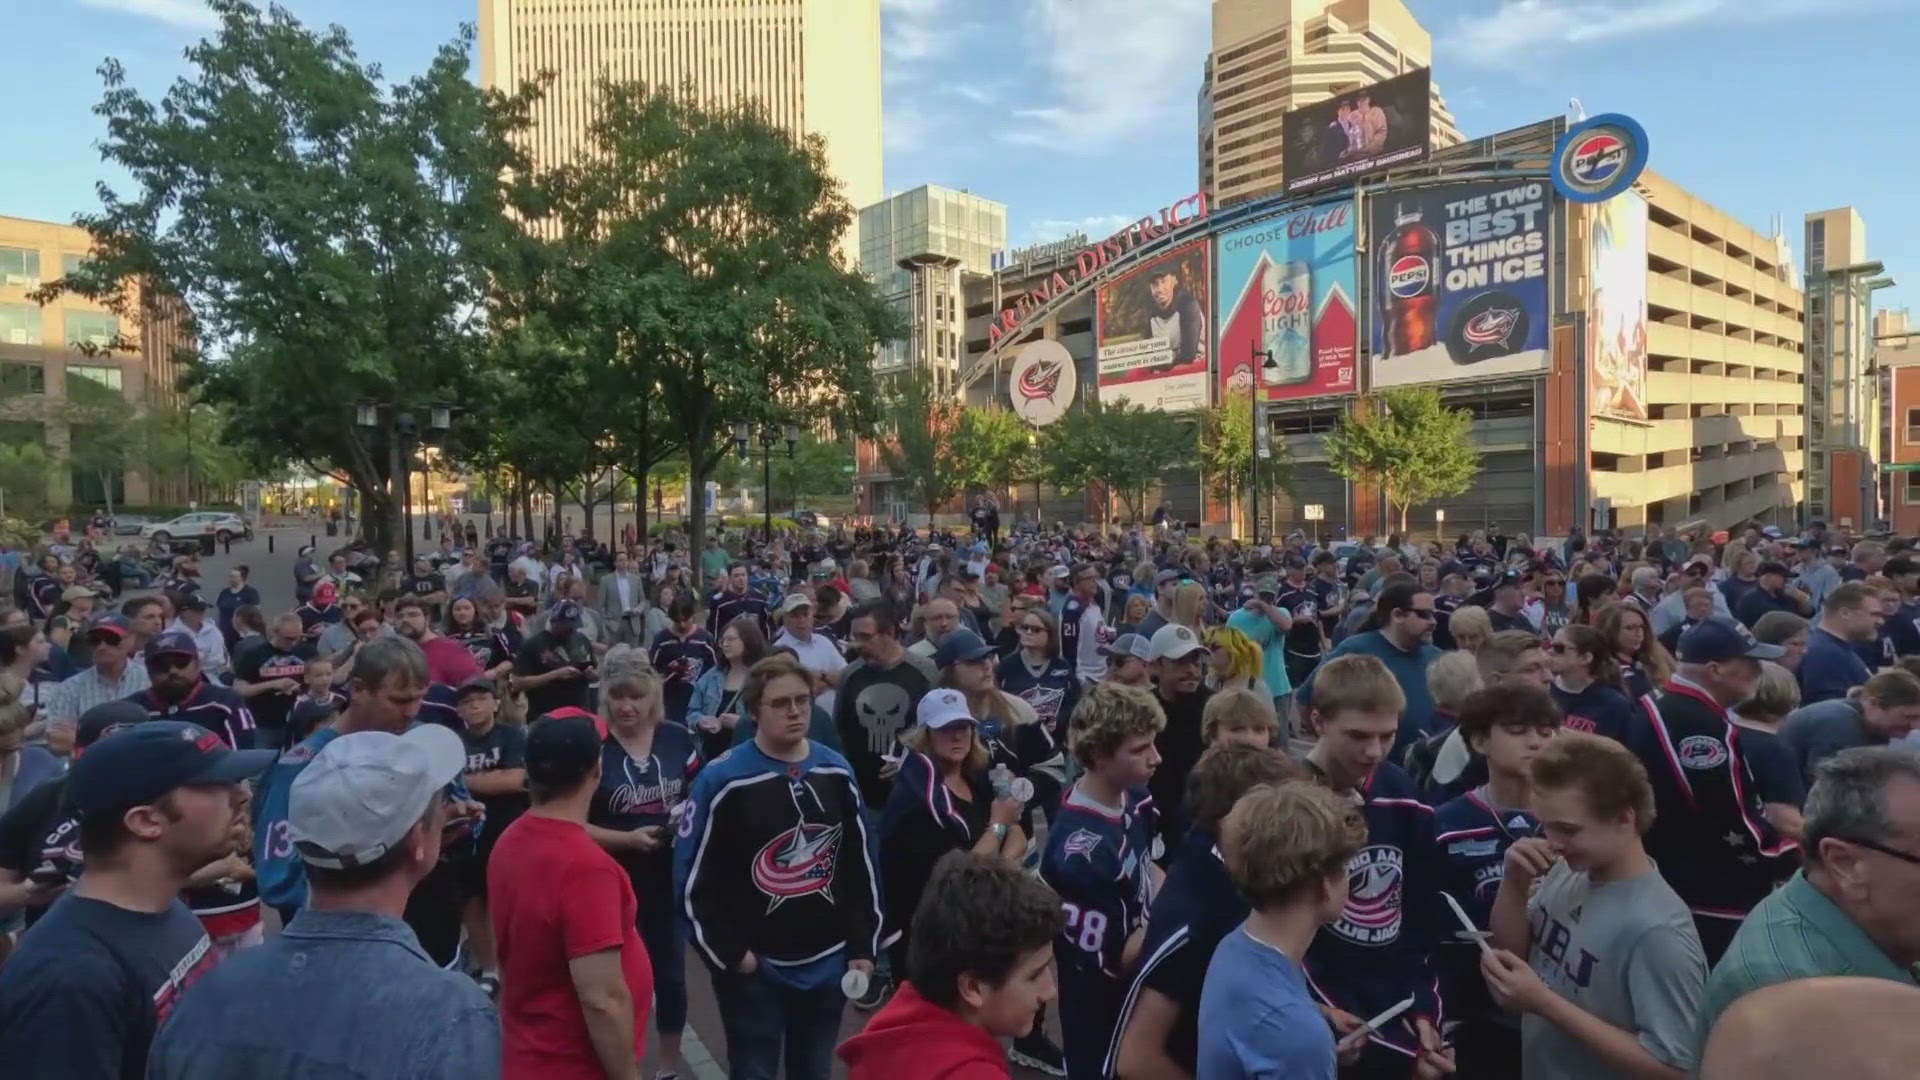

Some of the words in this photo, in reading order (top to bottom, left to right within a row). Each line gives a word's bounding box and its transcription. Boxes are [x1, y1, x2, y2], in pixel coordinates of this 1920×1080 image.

[1445, 195, 1487, 218] THE
[1490, 183, 1542, 207] TWO
[1225, 228, 1281, 251] CHOOSE
[1287, 203, 1350, 240] Chill
[1445, 202, 1543, 247] BEST
[1011, 229, 1088, 264] Nationwide
[1445, 232, 1543, 266] THINGS
[989, 271, 1071, 348] ARENA
[1077, 190, 1209, 278] DISTRICT
[1391, 269, 1427, 284] PEPSI
[1445, 264, 1488, 291] ON
[1493, 254, 1545, 284] ICE
[1265, 312, 1308, 332] LIGHT
[1063, 622, 1077, 637] 21
[264, 819, 294, 860] 13
[1061, 902, 1107, 952] 28
[1332, 918, 1371, 942] LUE
